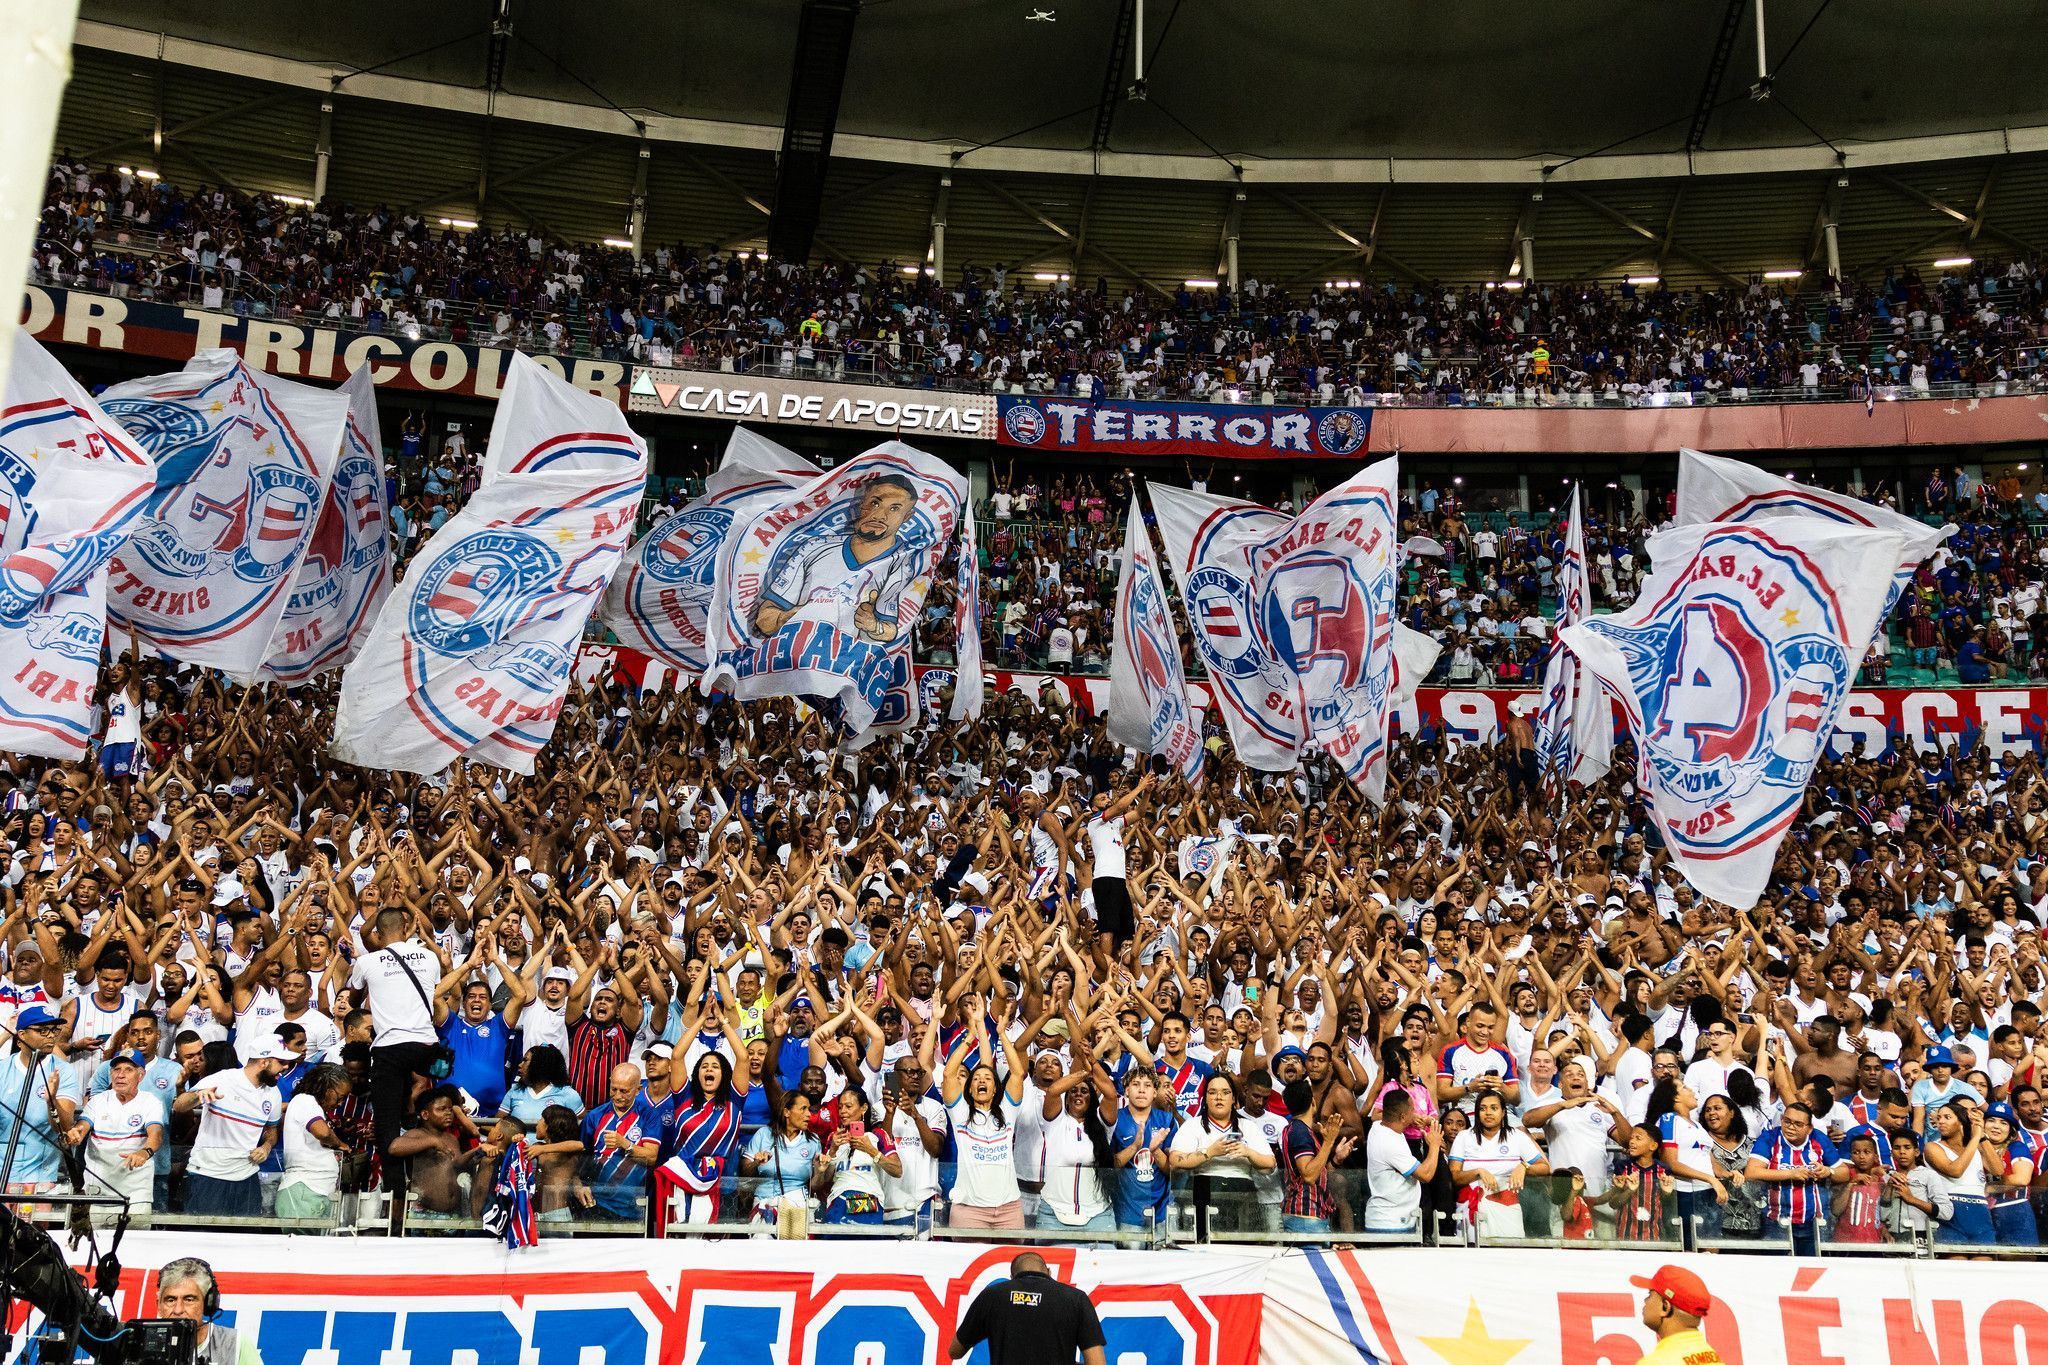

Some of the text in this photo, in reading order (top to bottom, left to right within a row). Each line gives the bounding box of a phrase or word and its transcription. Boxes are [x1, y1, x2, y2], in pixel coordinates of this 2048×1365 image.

[679, 386, 985, 433] CASA DE APOSTAS
[1047, 403, 1312, 452] TERROR
[1190, 571, 1229, 595] CLUB
[379, 952, 427, 964] PONCIA
[972, 1143, 1009, 1154] Esportes
[985, 1151, 1008, 1161] Sorte
[1012, 1292, 1039, 1303] BRAX
